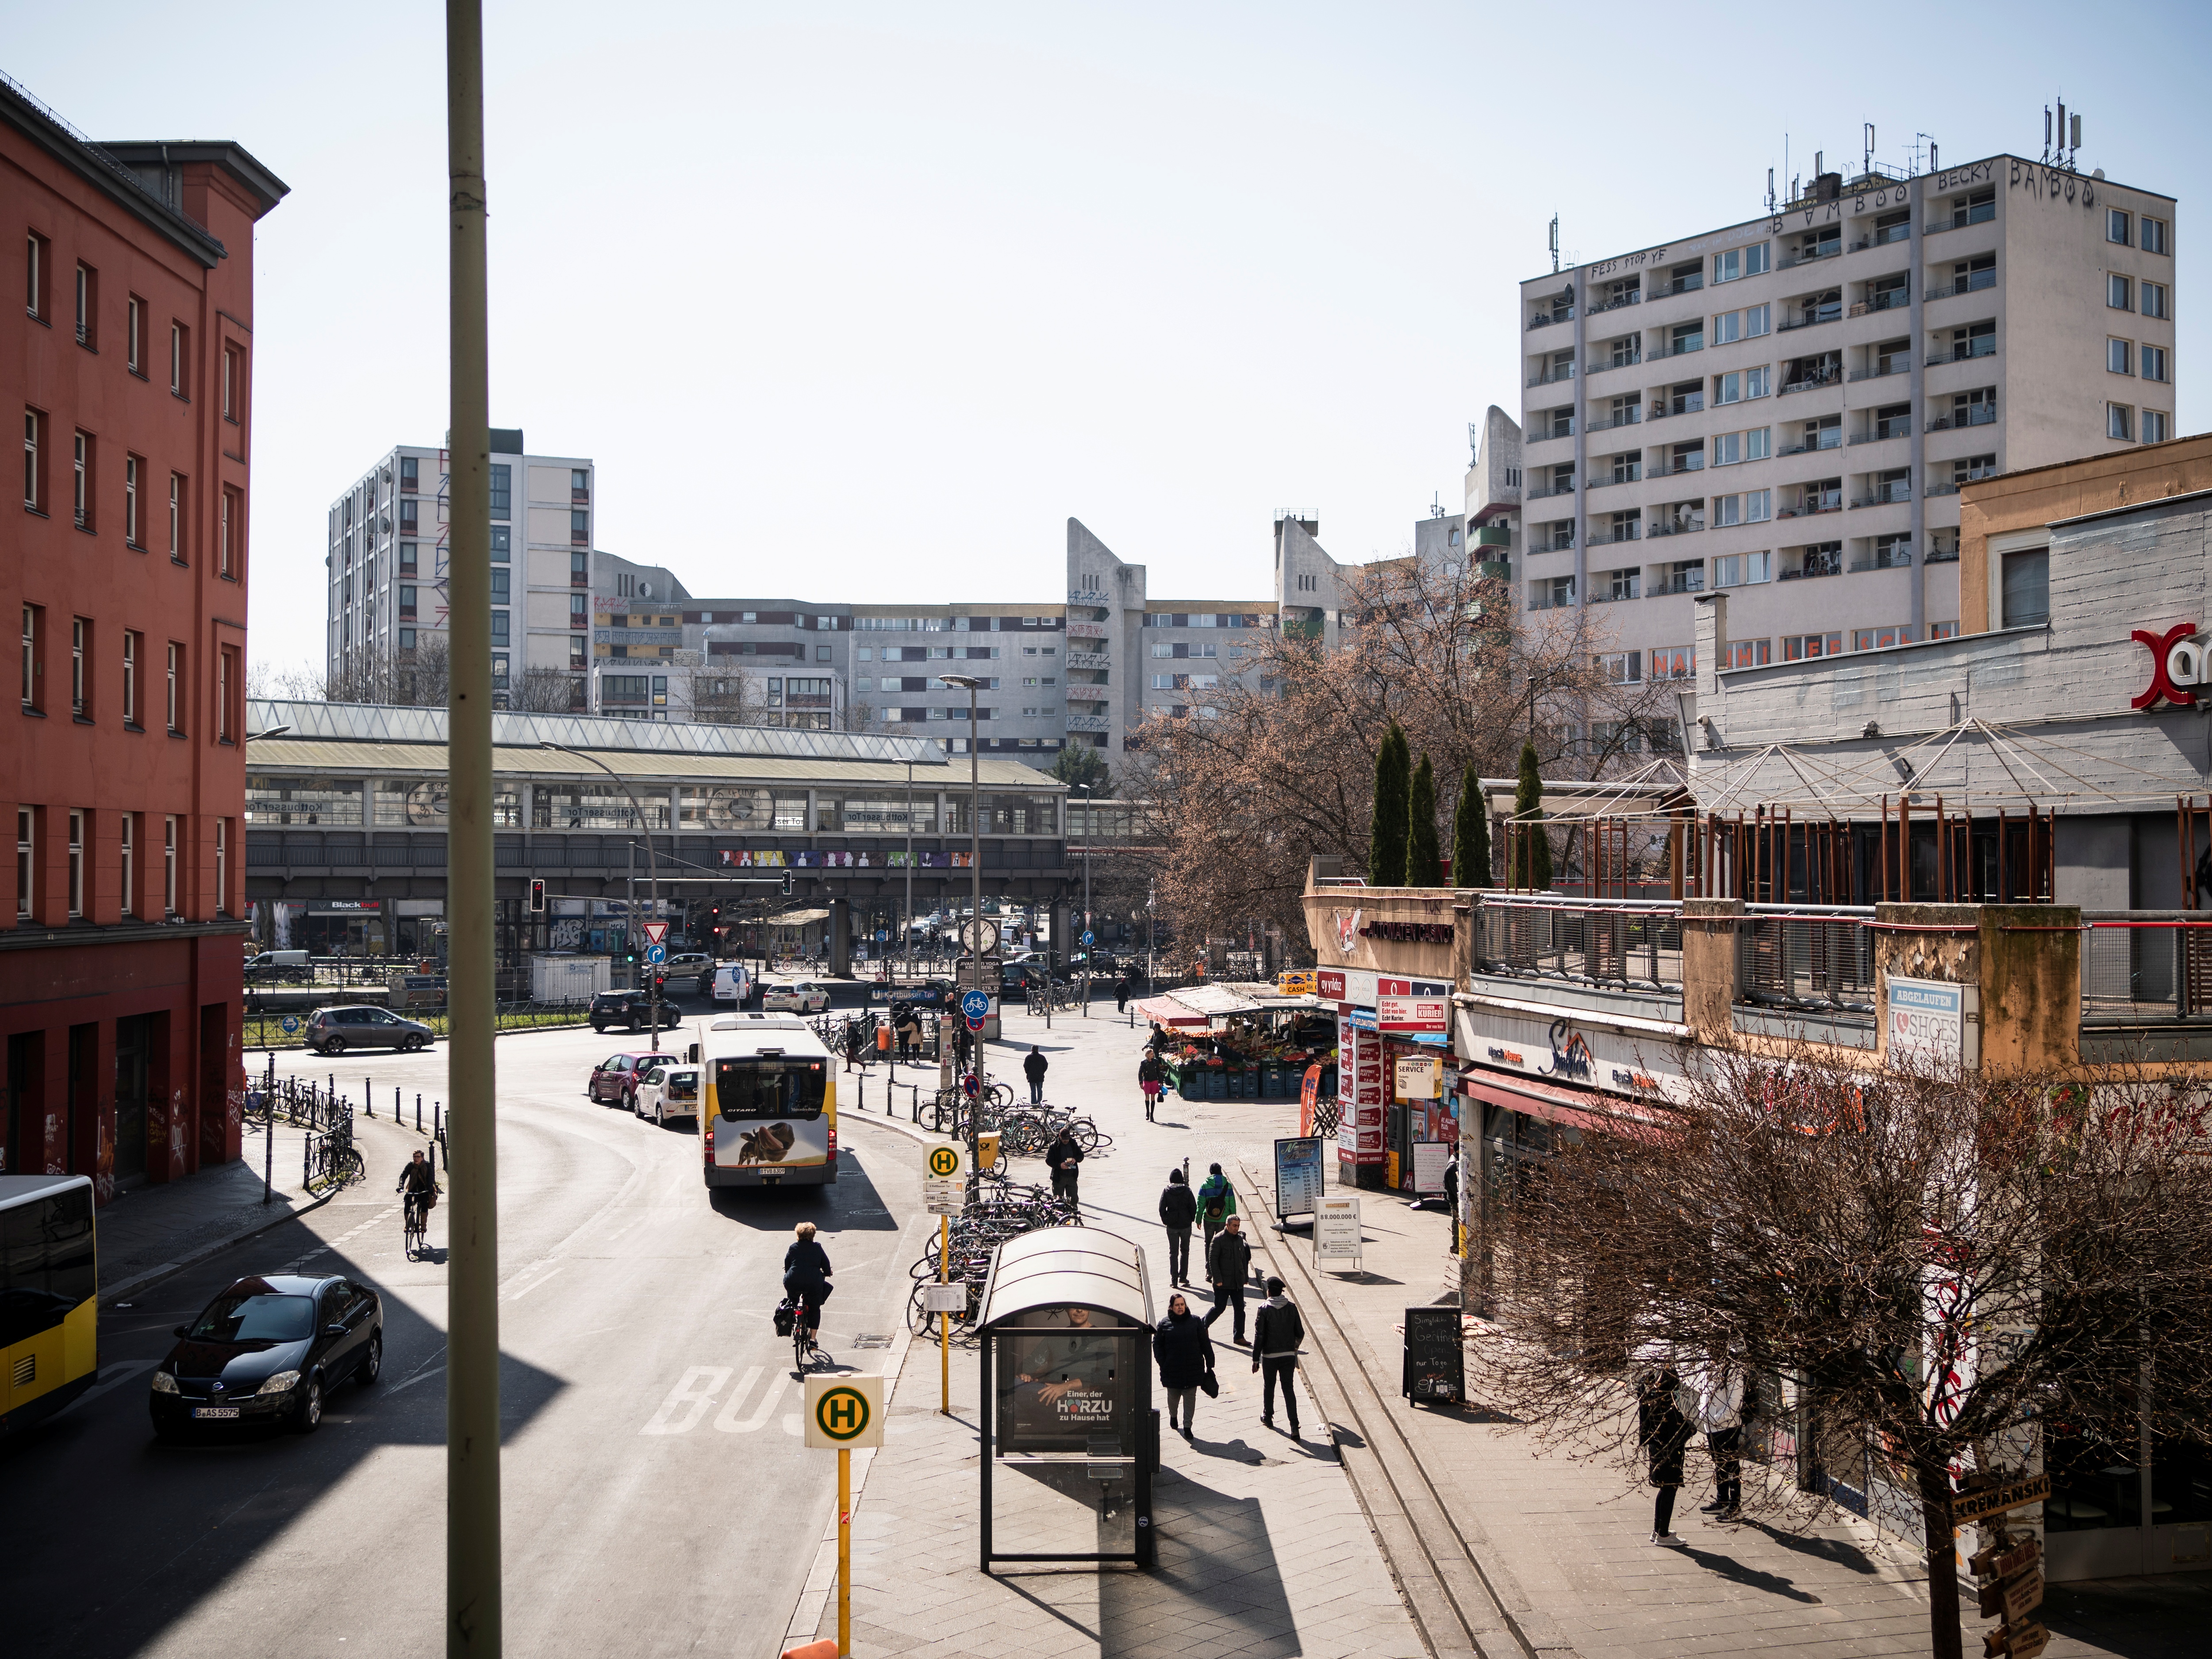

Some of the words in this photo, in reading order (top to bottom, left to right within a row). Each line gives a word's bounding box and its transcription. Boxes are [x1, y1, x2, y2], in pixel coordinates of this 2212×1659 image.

[1938, 161, 1993, 190] BECKY
[1592, 260, 1617, 279] FESS
[1624, 253, 1646, 269] STOP
[1368, 921, 1416, 941] AUTOMATEN
[1419, 923, 1450, 943] CASINO
[872, 990, 880, 999] U
[1897, 990, 1952, 1007] ABGELAUFEN
[1356, 1018, 1376, 1028] GELDAUTOMA
[1891, 1012, 1895, 1033] I
[1909, 1014, 1958, 1043] SHOES
[1488, 1046, 1522, 1063] BackHaus
